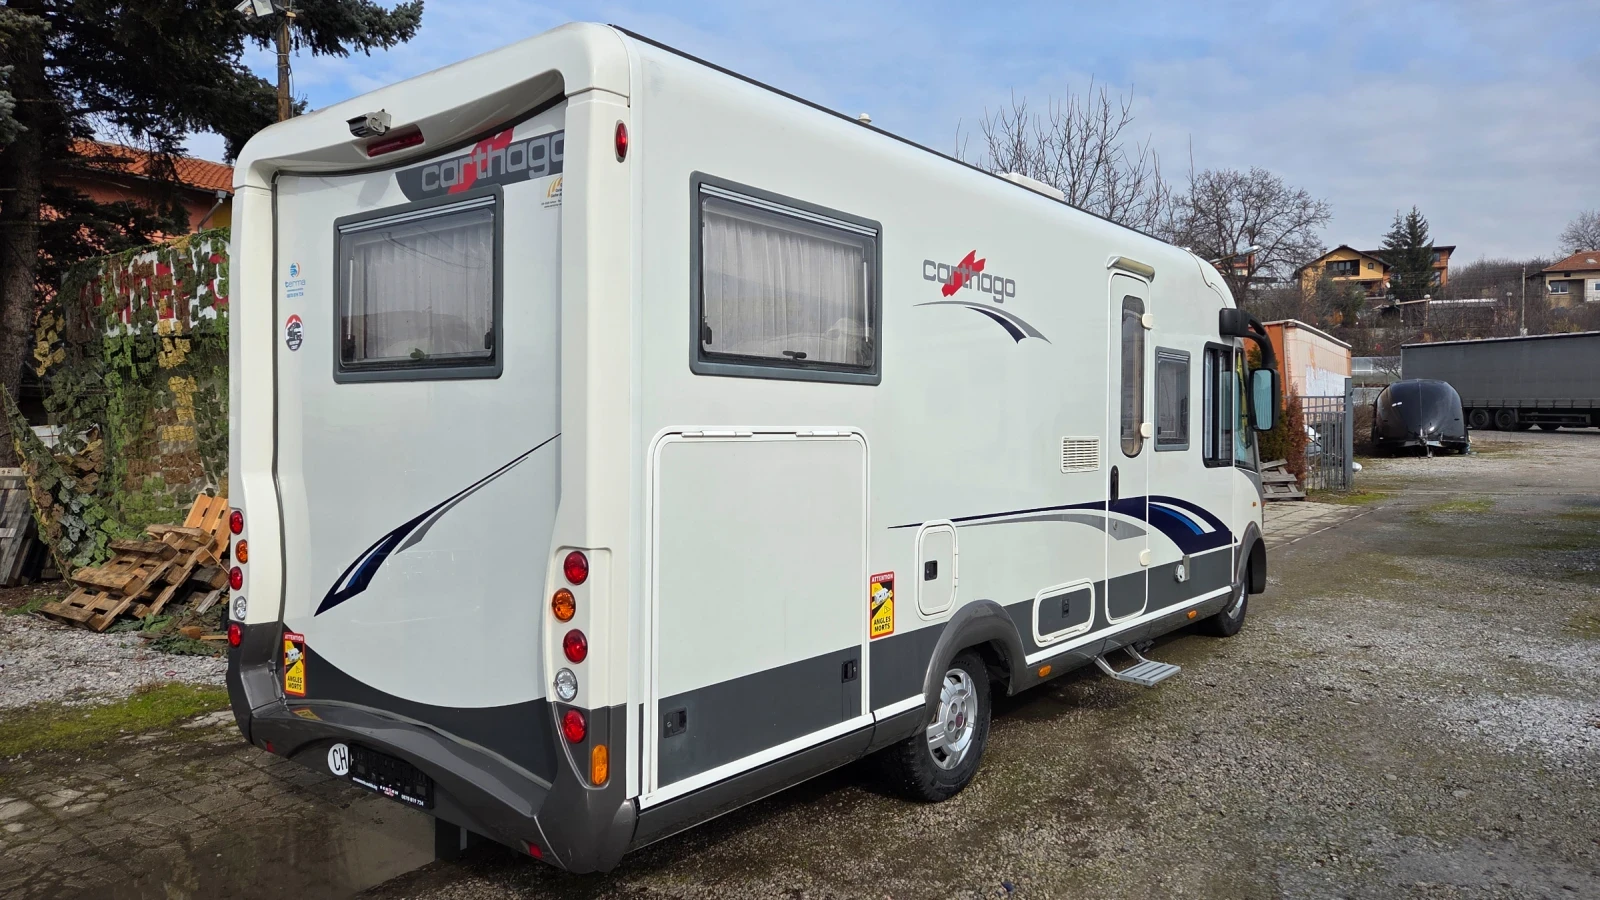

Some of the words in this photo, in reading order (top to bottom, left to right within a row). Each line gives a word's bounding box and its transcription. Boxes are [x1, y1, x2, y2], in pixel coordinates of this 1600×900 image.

[422, 133, 565, 192] carthago
[922, 258, 1016, 304] carthago
[871, 573, 894, 582] ATTENTION
[873, 616, 892, 626] ANGLES
[874, 622, 891, 632] MORTS
[287, 676, 303, 684] ANGLES
[287, 682, 302, 691] MORTS
[332, 746, 348, 772] CH
